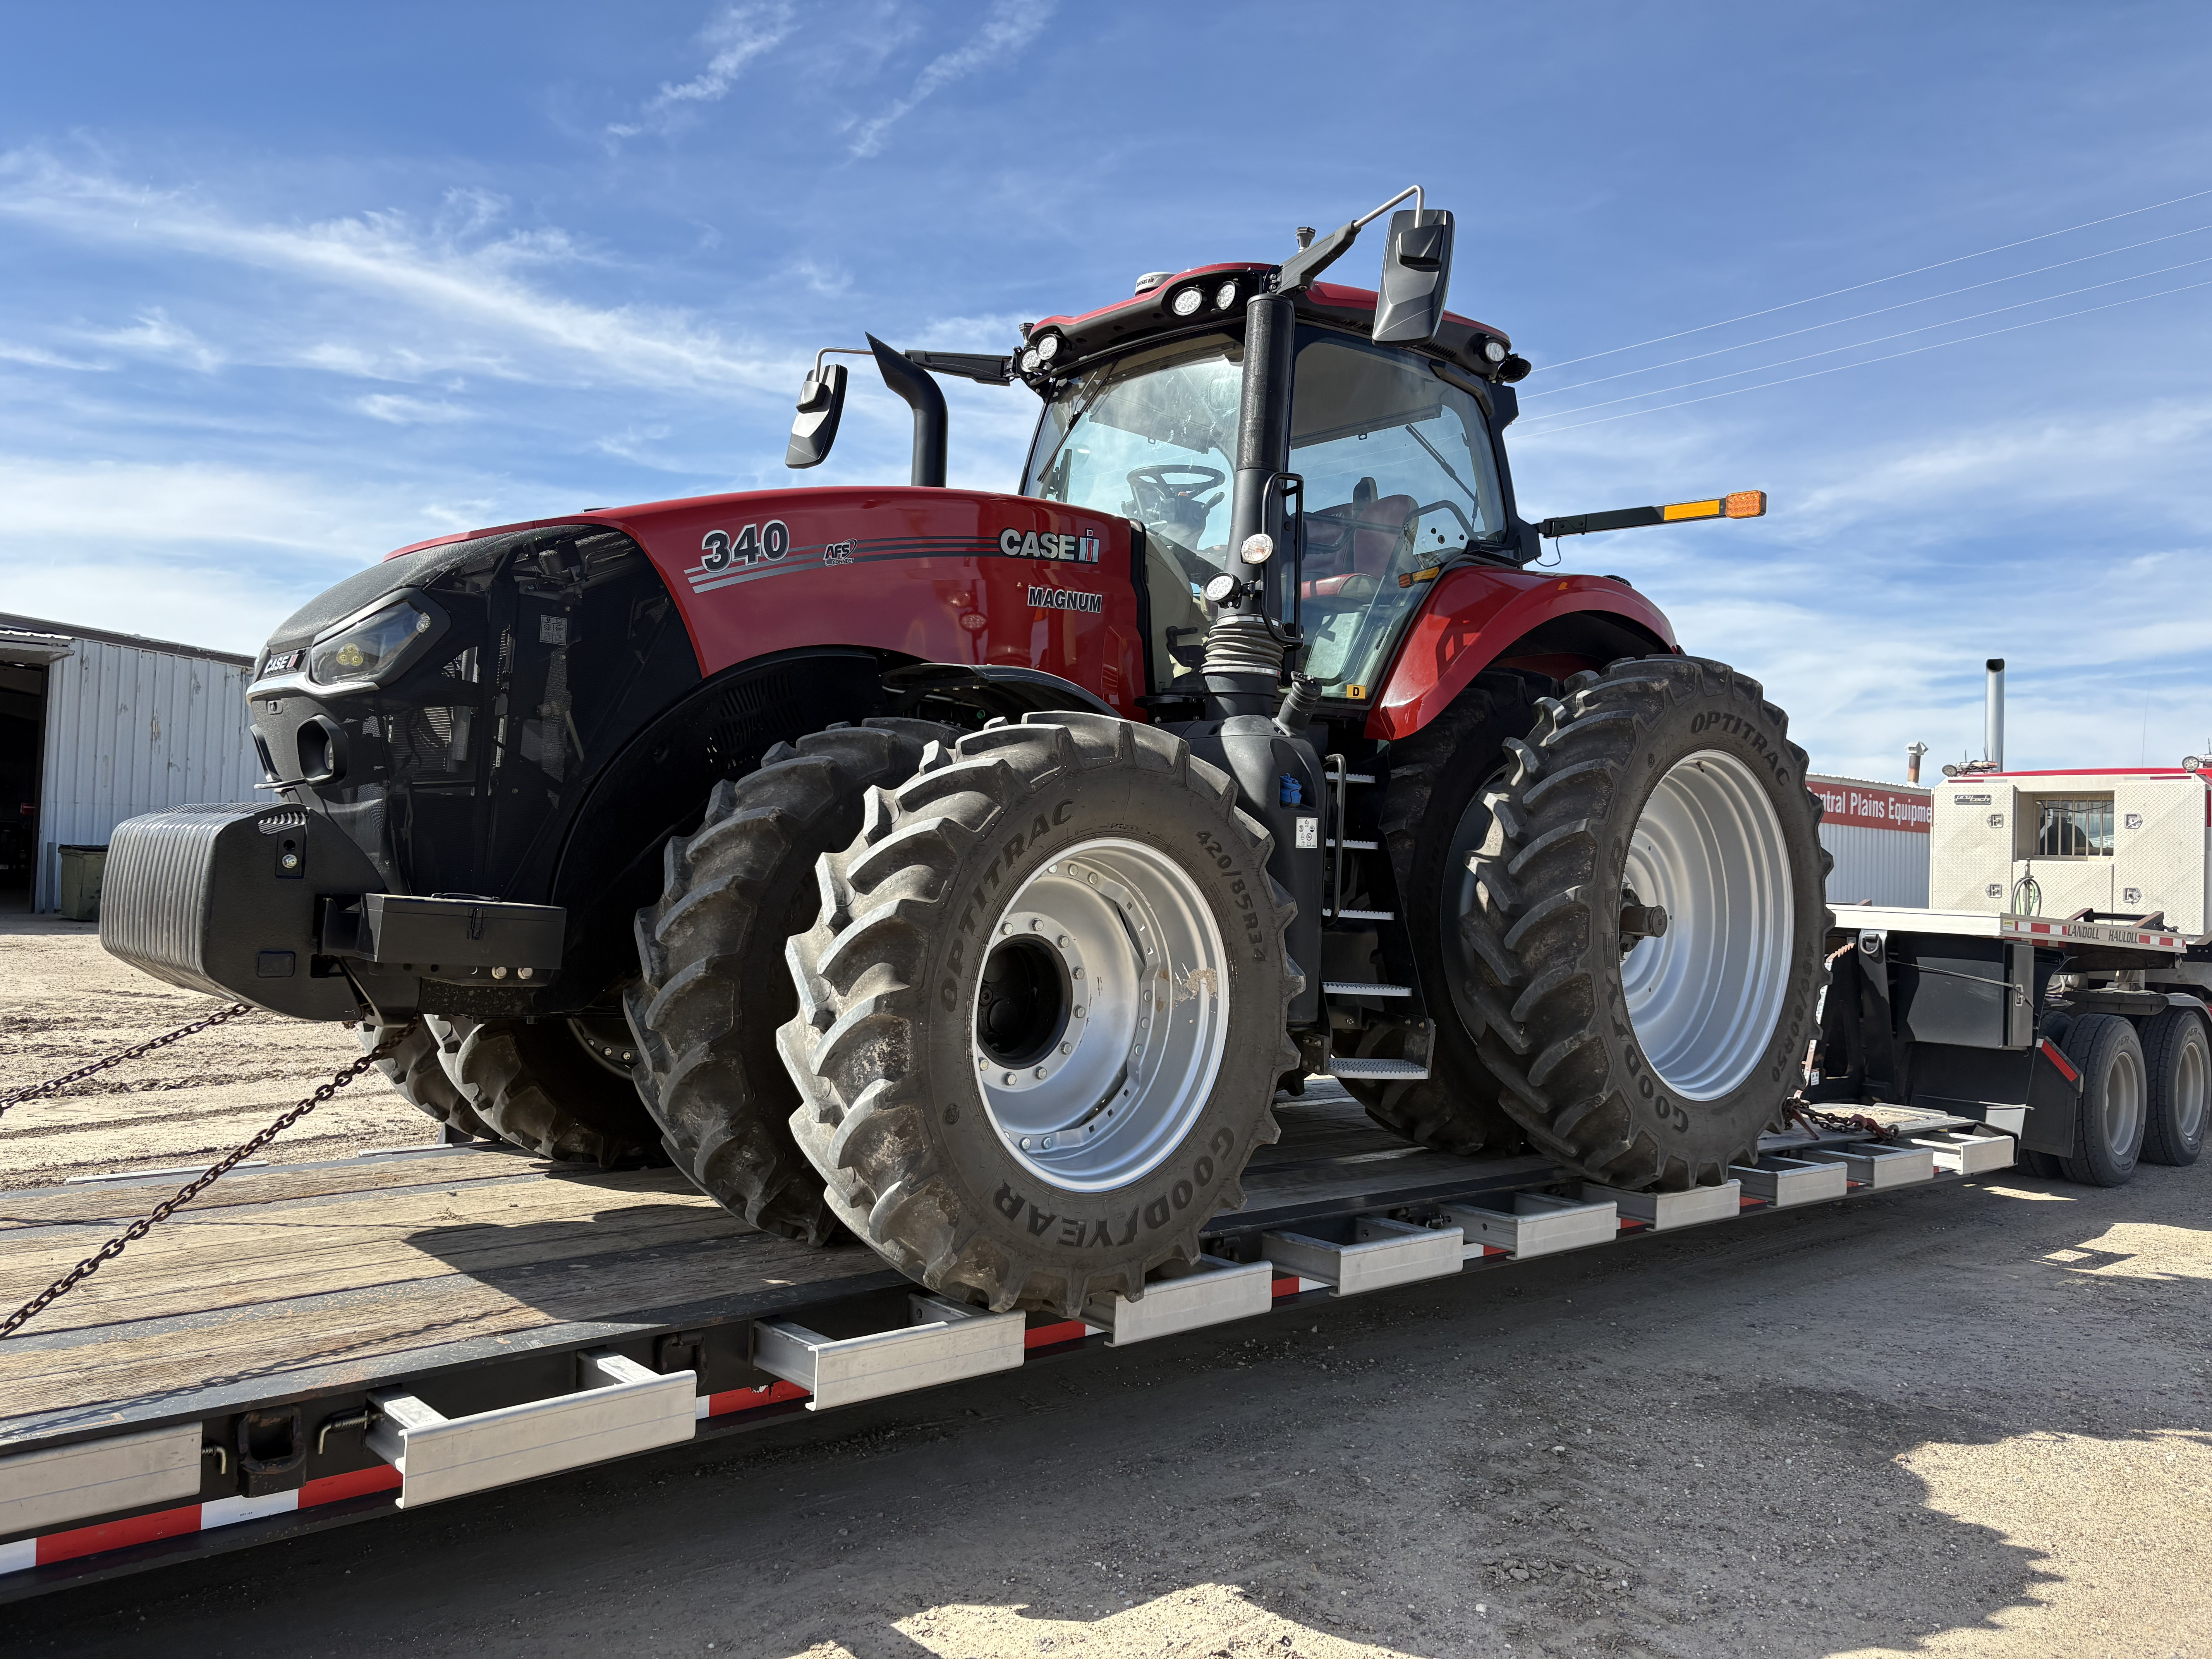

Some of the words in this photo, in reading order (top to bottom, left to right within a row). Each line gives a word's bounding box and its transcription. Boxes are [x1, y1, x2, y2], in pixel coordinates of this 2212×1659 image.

[701, 519, 790, 573] 340
[824, 543, 851, 560] AFS
[1000, 529, 1076, 559] CASE
[1027, 586, 1103, 613] MAGNUM
[264, 655, 290, 673] CASE
[1353, 687, 1360, 696] D
[1690, 712, 1792, 786] OPTITRAC
[1807, 786, 1846, 814] ntral
[1850, 792, 1885, 818] Plains
[1888, 797, 1931, 827] Equipme
[940, 799, 1074, 1013] OPTITRAC
[1195, 831, 1267, 963] 420/85R34
[2067, 924, 2100, 939] LANDOLL
[2108, 932, 2138, 944] HAULOLL
[993, 1125, 1235, 1250] GOODYEAR
